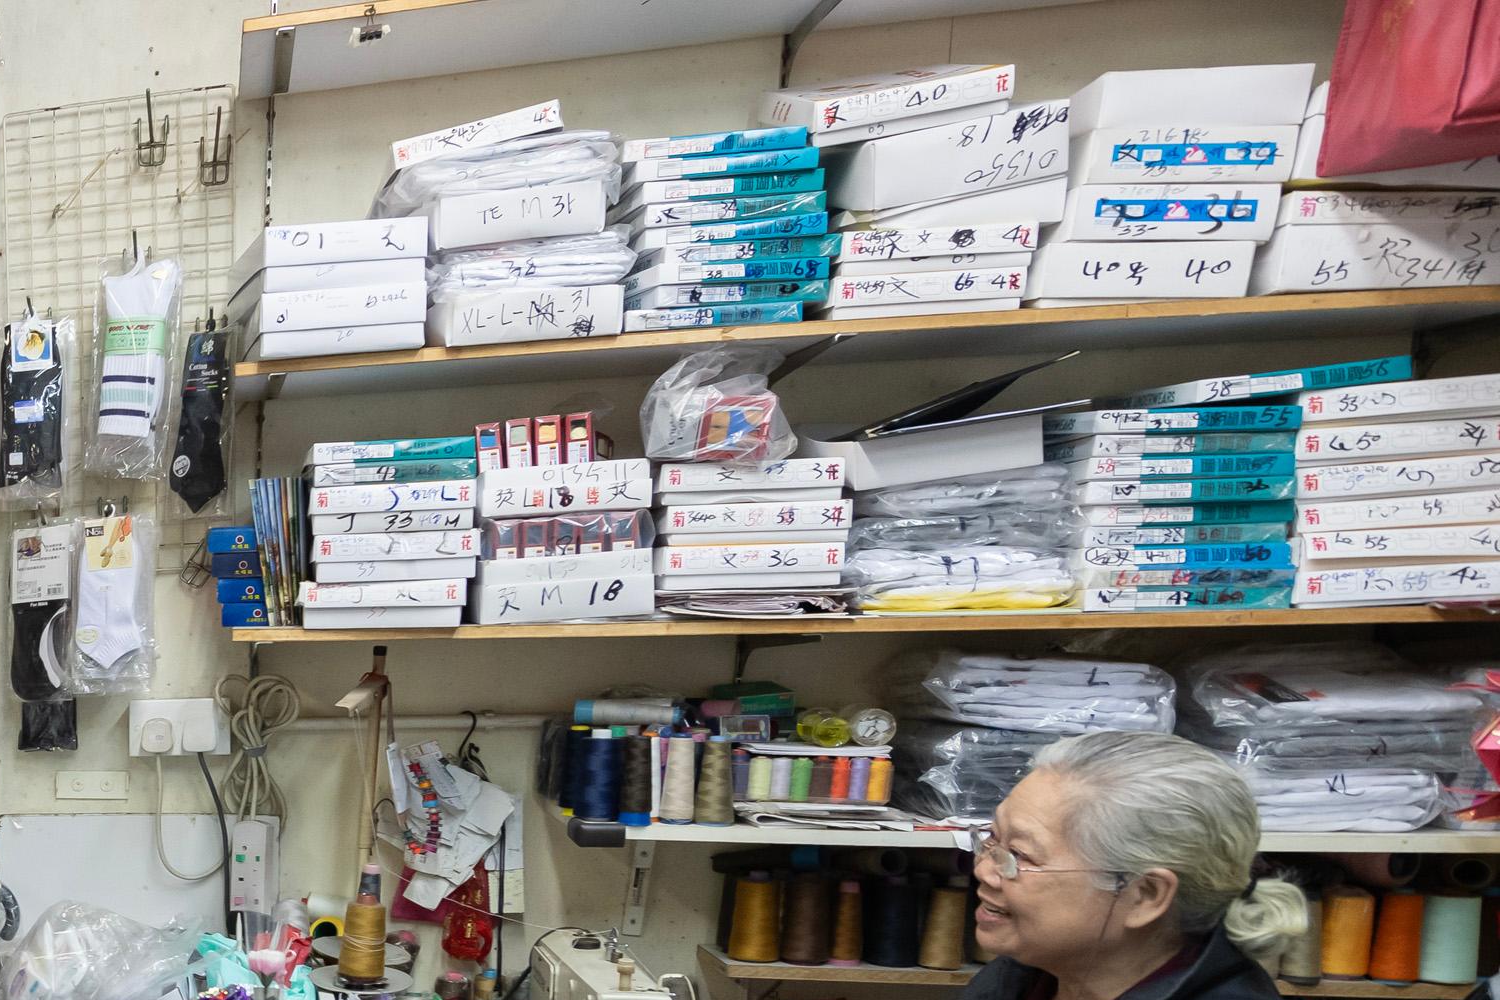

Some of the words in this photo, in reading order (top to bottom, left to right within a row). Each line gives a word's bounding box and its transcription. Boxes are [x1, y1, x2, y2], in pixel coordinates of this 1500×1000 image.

[996, 74, 1009, 93] 花
[477, 206, 504, 225] TE
[1300, 197, 1316, 217] 菊
[1185, 258, 1232, 284] 40
[1310, 259, 1351, 286] 55
[842, 282, 854, 299] 菊
[1203, 379, 1232, 401] 38
[1308, 396, 1323, 413] 菊
[1258, 407, 1293, 426] 55
[1305, 435, 1319, 452] 菊
[669, 468, 682, 485] 菊
[716, 467, 742, 482] 文
[1303, 474, 1318, 491] 菊
[317, 491, 329, 508] 菊
[459, 485, 470, 502] 花
[384, 510, 413, 531] 33
[445, 513, 460, 527] M
[673, 511, 685, 527] 菊
[1304, 509, 1320, 525] 菊
[320, 540, 332, 556] 菊
[461, 535, 472, 551] 花
[1312, 536, 1327, 551] 菊
[1364, 534, 1390, 550] 55
[670, 552, 682, 568] 菊
[826, 548, 839, 564] 花
[767, 549, 799, 568] 36
[1450, 565, 1486, 584] 42
[445, 585, 457, 599] 花
[541, 585, 562, 605] M
[589, 578, 624, 606] 18
[1307, 577, 1322, 594] 菊
